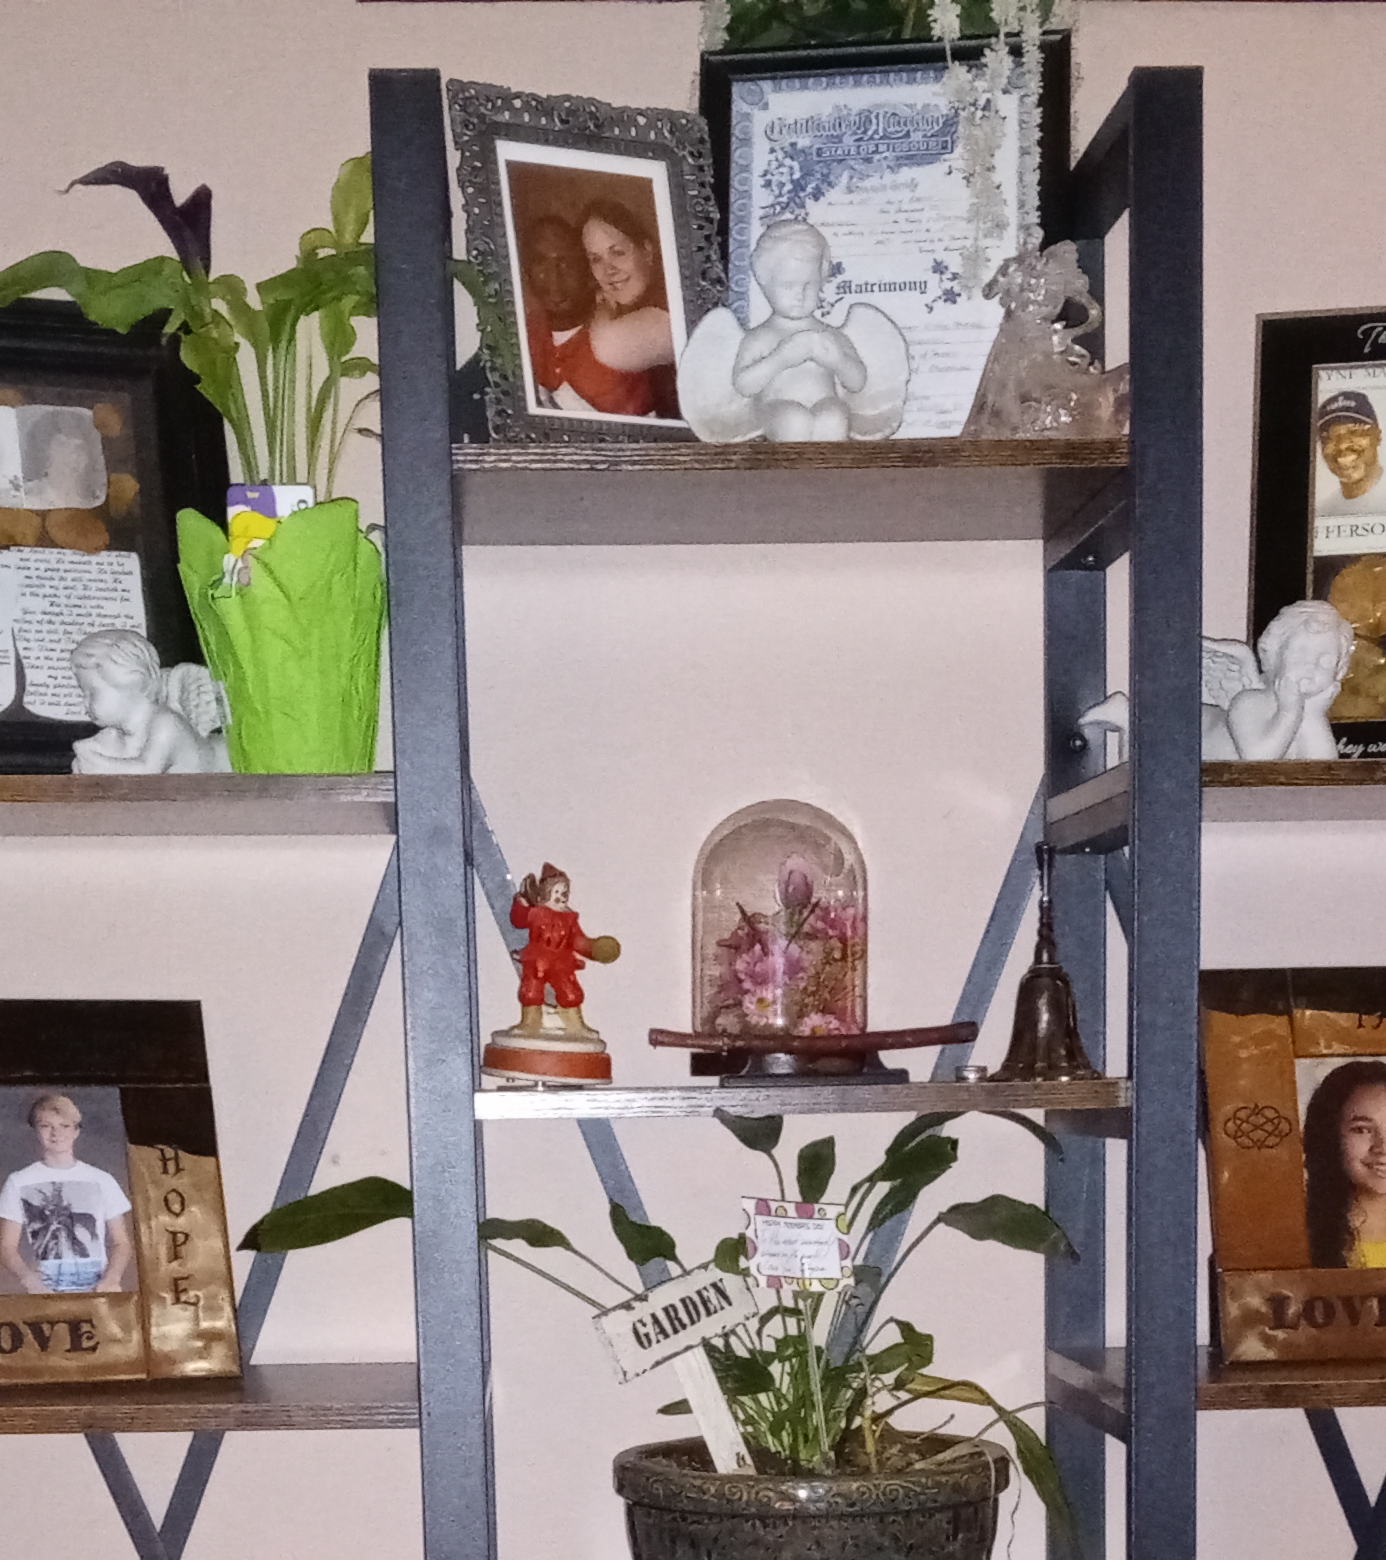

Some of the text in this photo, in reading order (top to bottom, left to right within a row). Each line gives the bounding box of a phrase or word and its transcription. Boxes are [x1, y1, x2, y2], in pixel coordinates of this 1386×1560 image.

[822, 141, 943, 157] STATE OF MISSOURI
[834, 279, 928, 295] Matrimony
[1335, 737, 1365, 759] hey
[156, 1145, 199, 1307] HOPE
[631, 1277, 734, 1352] GARDEN
